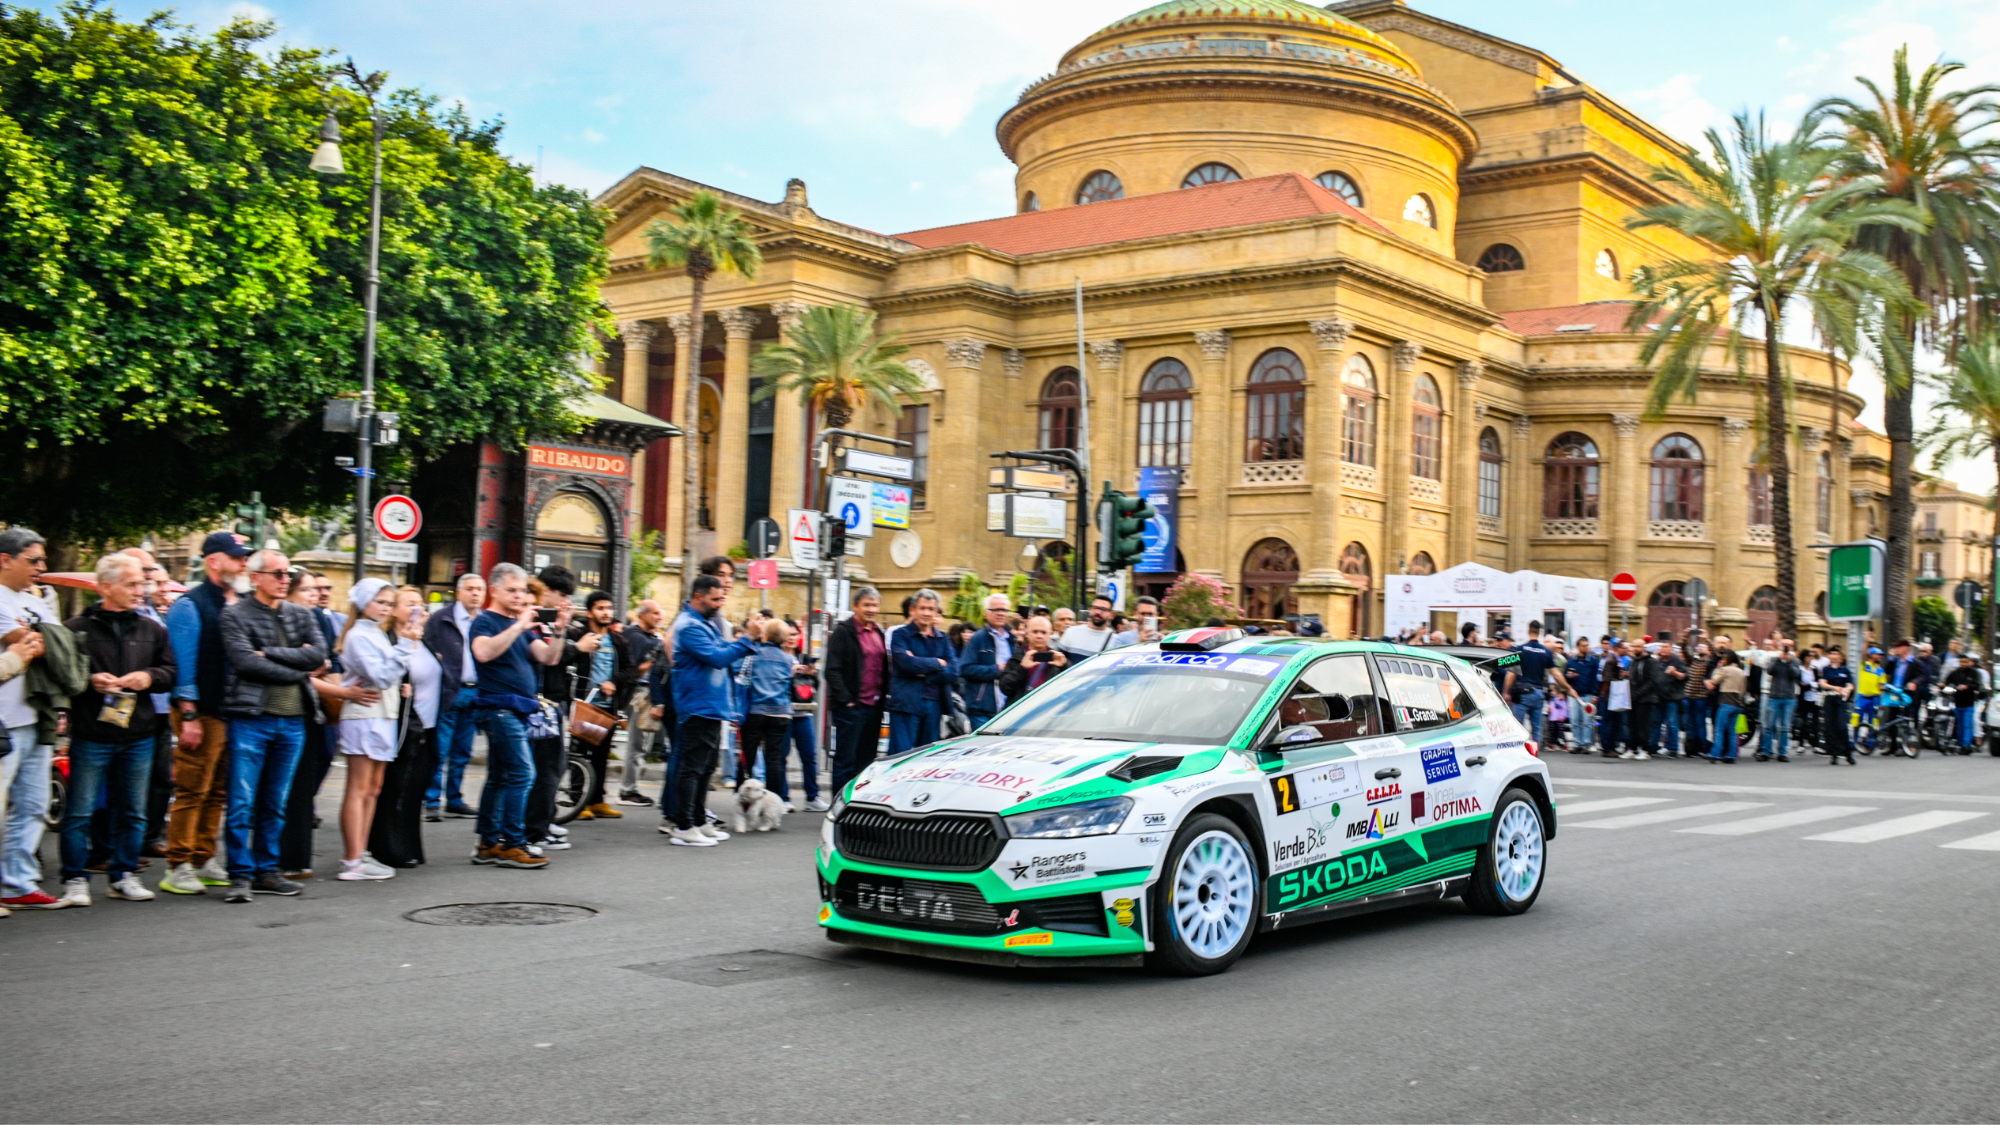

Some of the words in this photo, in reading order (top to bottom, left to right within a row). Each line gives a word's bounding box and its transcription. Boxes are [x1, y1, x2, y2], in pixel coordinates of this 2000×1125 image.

[531, 448, 626, 473] RIBAUDO
[1122, 652, 1228, 667] sparco
[1440, 680, 1462, 719] 2
[1422, 747, 1454, 762] GRAPHIC
[1426, 762, 1458, 780] SERVICE
[1277, 777, 1294, 812] 2
[1143, 816, 1166, 824] OMP
[1433, 796, 1482, 821] OPTIMA
[1031, 851, 1087, 867] Rangers
[1273, 835, 1305, 862] Verde
[857, 882, 955, 921] DELTA
